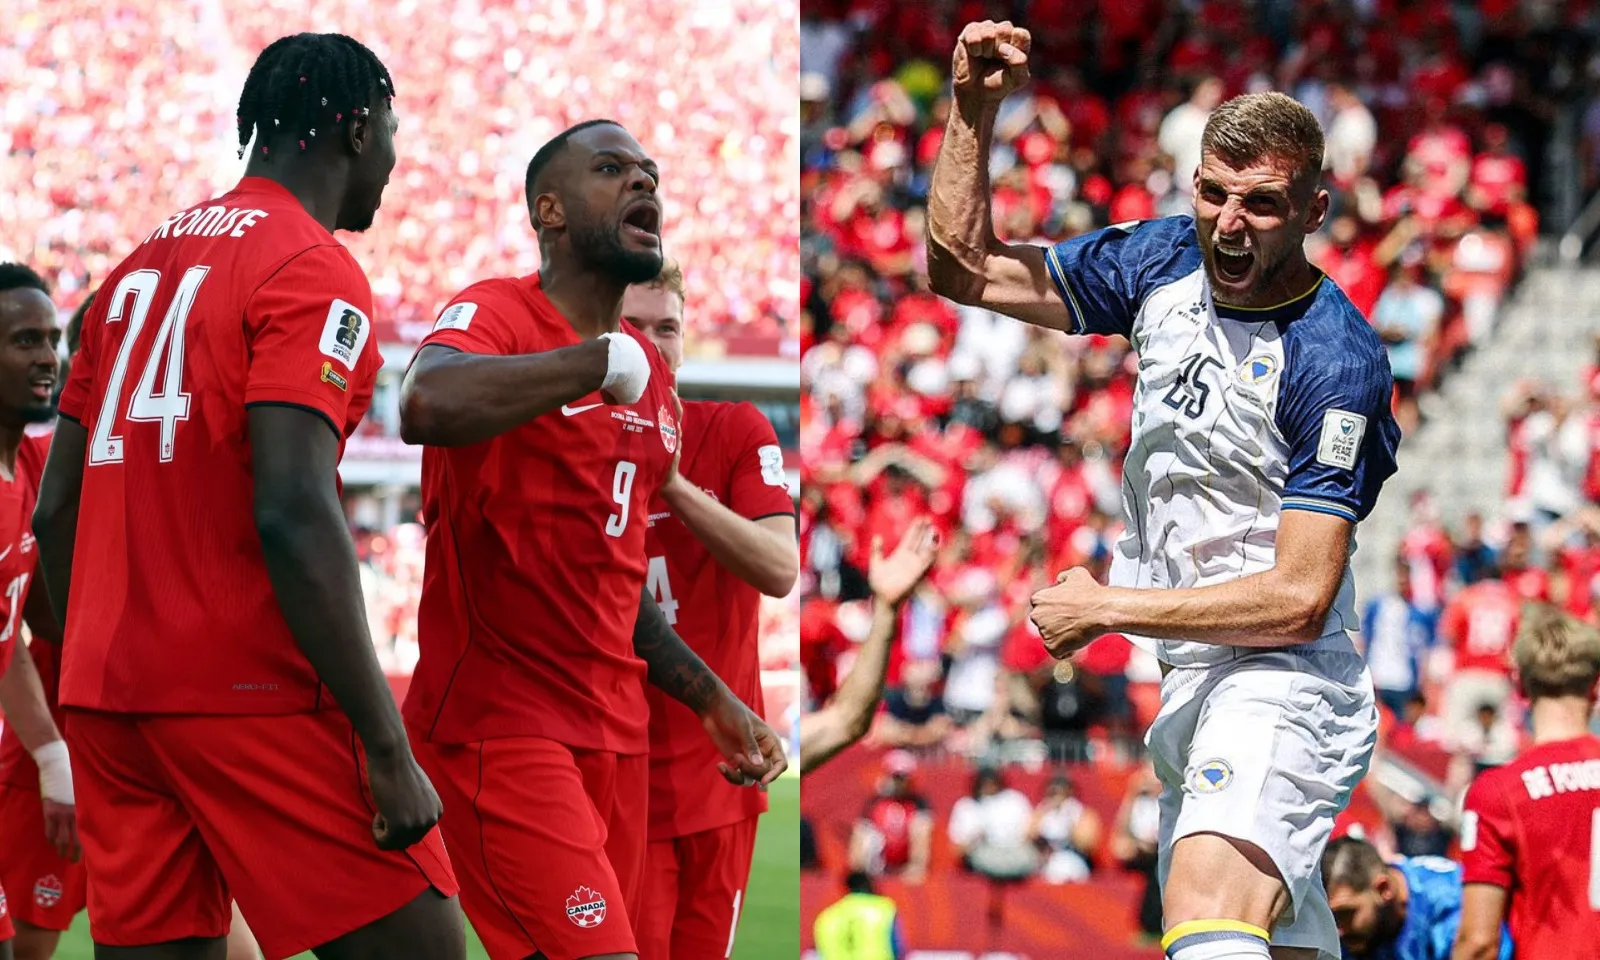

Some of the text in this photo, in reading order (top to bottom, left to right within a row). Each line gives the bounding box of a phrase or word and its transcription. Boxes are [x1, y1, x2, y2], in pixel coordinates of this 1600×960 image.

[88, 265, 211, 467] 24
[1162, 352, 1226, 420] 25
[605, 460, 637, 538] 9
[566, 901, 606, 916] CANADA
